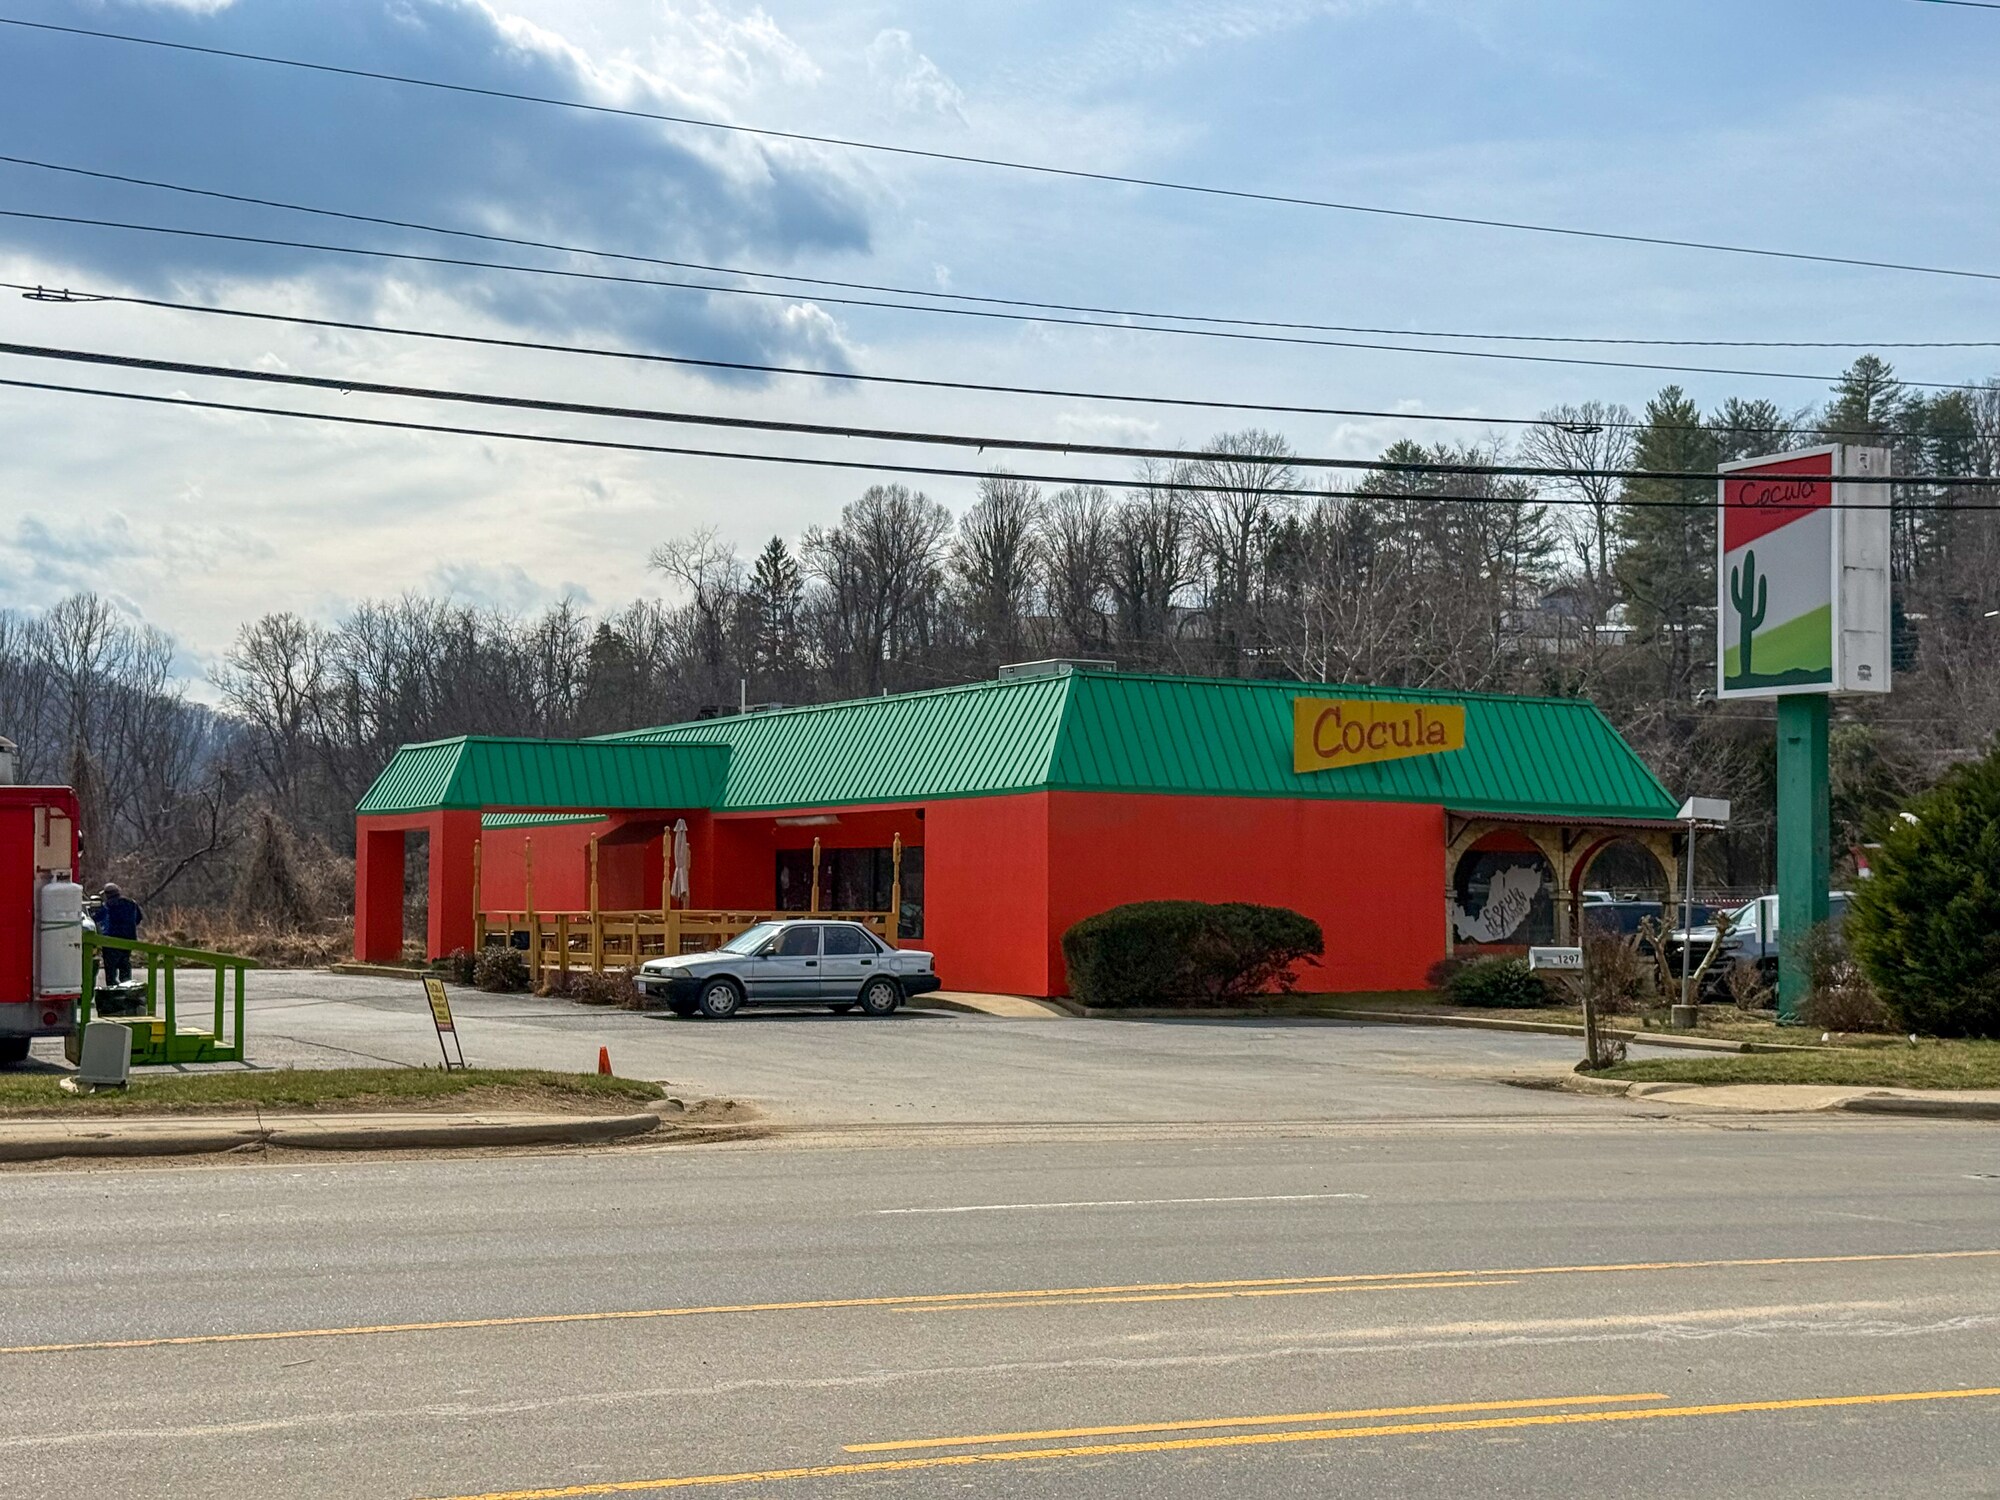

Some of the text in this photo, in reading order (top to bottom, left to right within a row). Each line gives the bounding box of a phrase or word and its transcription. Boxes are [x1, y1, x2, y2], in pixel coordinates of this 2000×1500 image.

[1739, 481, 1816, 506] Cocula
[1313, 706, 1447, 758] Cocula
[1558, 954, 1579, 964] 1297
